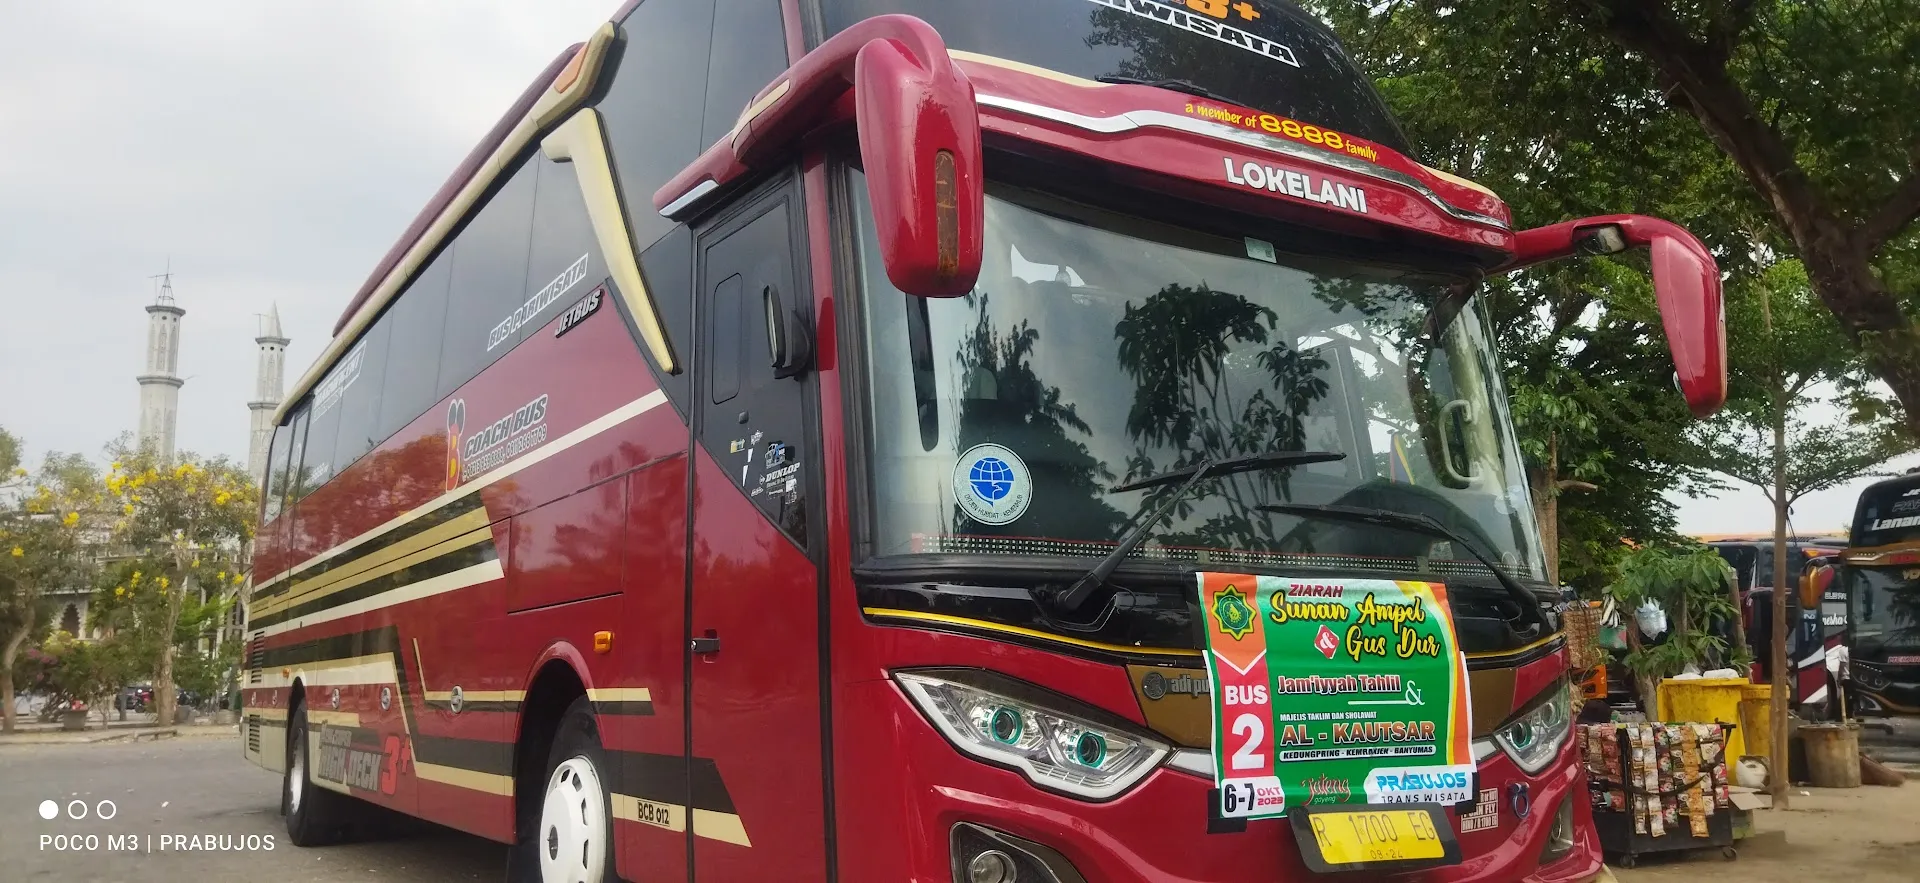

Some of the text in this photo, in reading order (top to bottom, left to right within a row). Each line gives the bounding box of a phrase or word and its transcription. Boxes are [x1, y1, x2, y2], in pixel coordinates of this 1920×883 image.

[1185, 103, 1377, 162] a member of 8888 family
[1223, 157, 1368, 214] LOKELANI
[554, 288, 603, 337] JETBUS
[464, 393, 549, 462] COACH BUS
[765, 462, 801, 483] DUNLOP
[1288, 584, 1344, 597] ZIARAH
[1270, 590, 1426, 634] Sunan Ampel
[1319, 624, 1441, 662] & Gus Dur
[1171, 674, 1192, 693] adi
[1225, 684, 1268, 706] BUS
[1278, 674, 1401, 694] Jam'iyyah Tahlil
[1405, 680, 1425, 706] &
[1279, 711, 1377, 722] MAJELIS TAKLIM DAN SHOLAWAT
[1231, 712, 1265, 770] 2
[1280, 723, 1314, 747] AL
[1332, 720, 1435, 746] KAUTSAR
[1283, 750, 1340, 760] KEDUNGPRING
[1394, 746, 1433, 754] BANYUMAS
[1256, 787, 1281, 797] OKT
[1375, 770, 1467, 792] PRABUJOS
[1224, 783, 1255, 813] 6-7
[1257, 796, 1284, 806] 2023
[1424, 791, 1466, 803] WISATA
[637, 801, 670, 825] BCB 012
[1312, 811, 1436, 847] R 1700 EG
